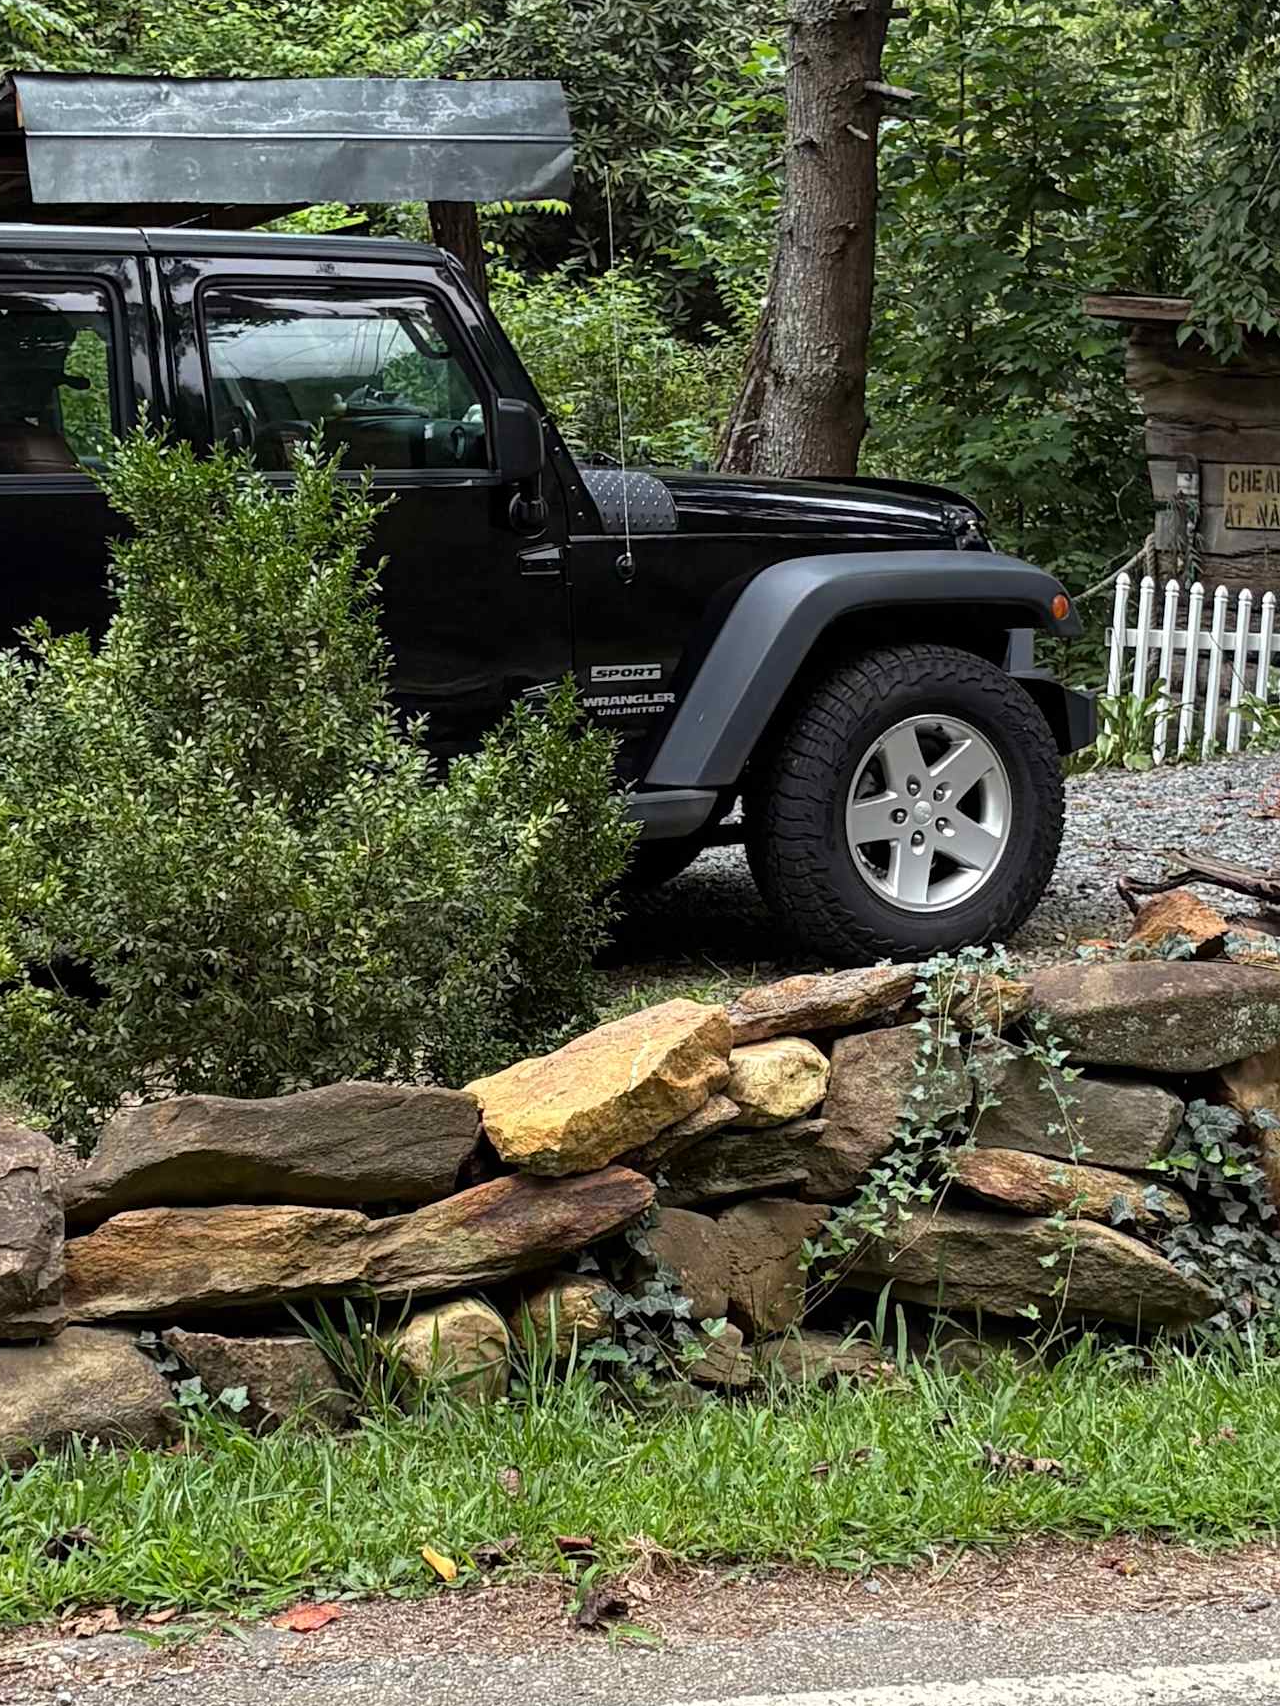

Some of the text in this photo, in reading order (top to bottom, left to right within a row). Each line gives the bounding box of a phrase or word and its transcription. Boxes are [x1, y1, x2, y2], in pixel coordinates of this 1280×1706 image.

[1225, 502, 1245, 526] AT
[594, 668, 658, 678] SPORT
[583, 693, 675, 707] WRANGLER
[597, 706, 665, 716] UNLIMITED
